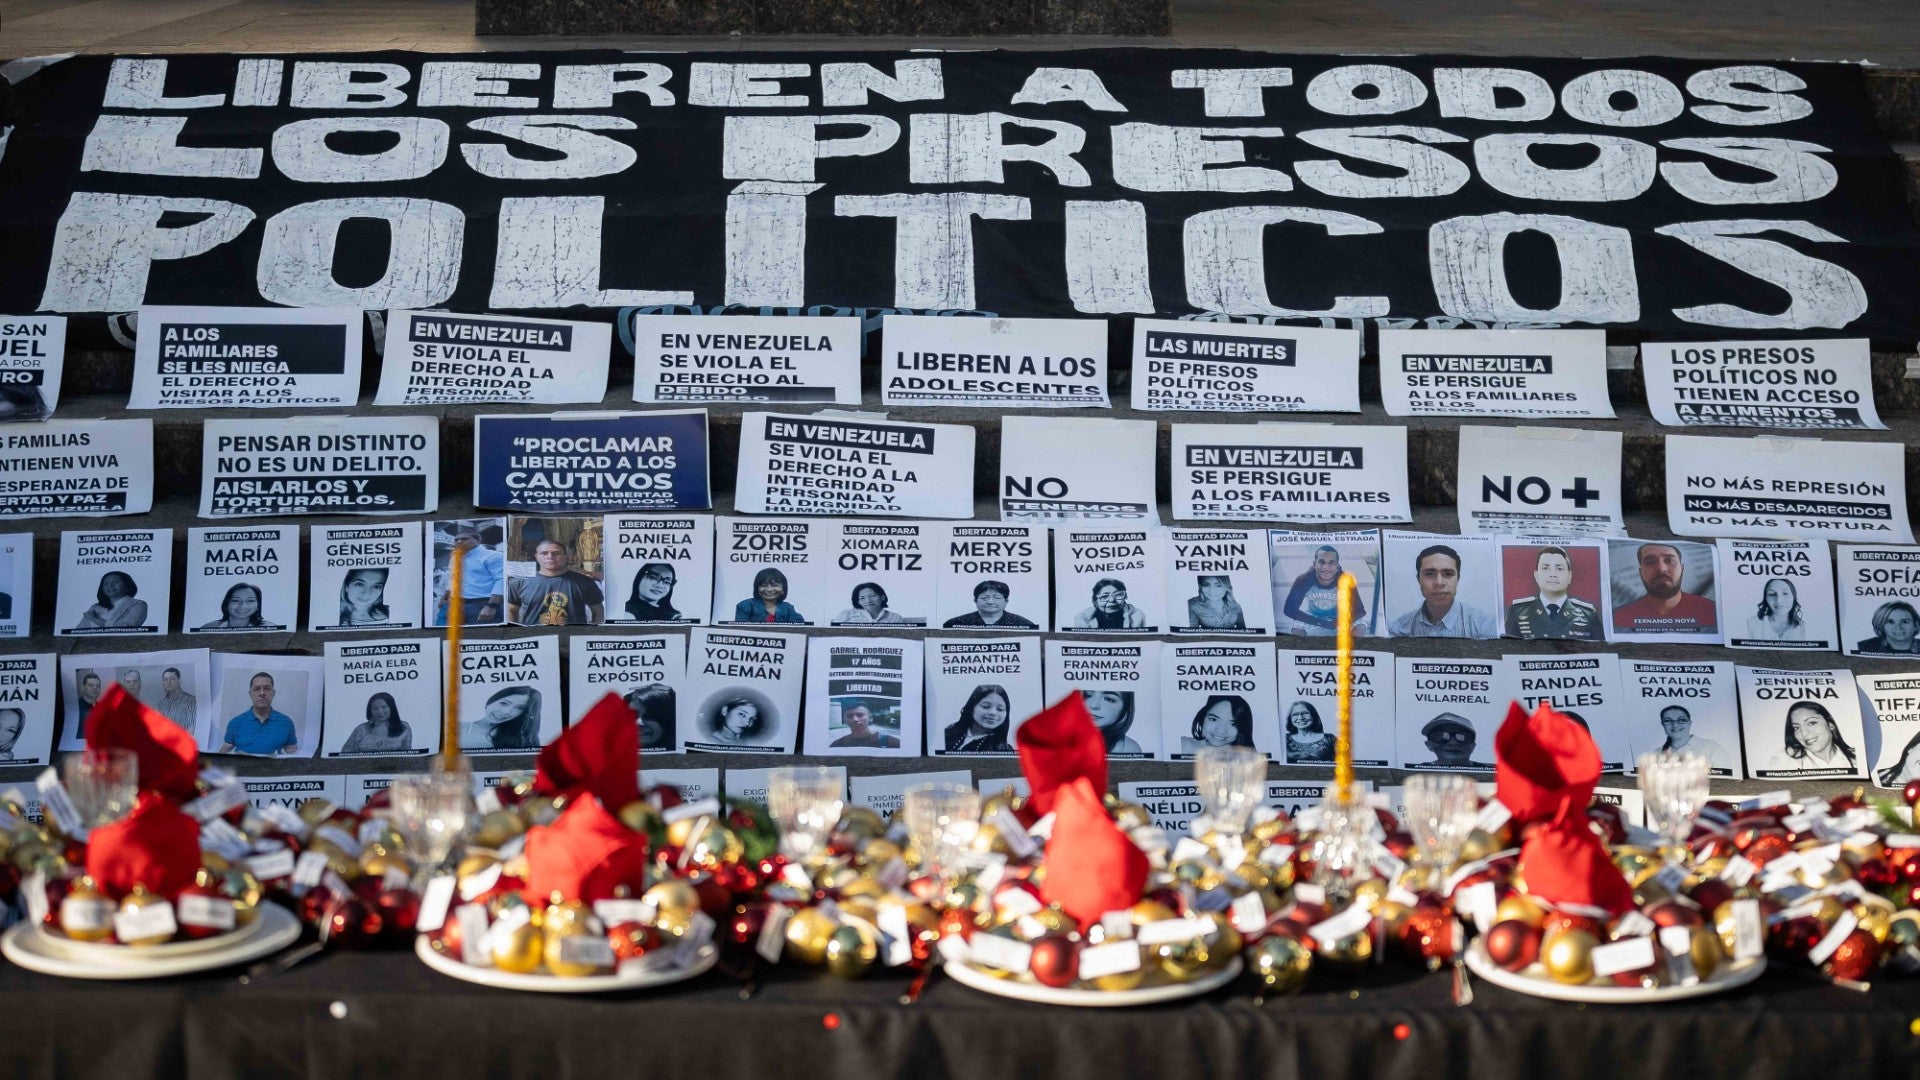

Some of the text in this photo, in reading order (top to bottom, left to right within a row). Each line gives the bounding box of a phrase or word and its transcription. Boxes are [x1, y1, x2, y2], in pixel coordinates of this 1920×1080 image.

[102, 58, 1814, 127] LIBEREN A TODOS
[80, 112, 1838, 204] LOS PRESOS
[36, 180, 1868, 329] POLÍTICOS
[2, 324, 47, 336] SAN
[165, 328, 220, 341] A LOS
[415, 322, 563, 346] EN VENEZUELA
[661, 334, 832, 351] EN VENEZUELA
[1150, 338, 1287, 360] LAS MUERTES
[164, 345, 278, 358] FAMILIARES
[412, 344, 530, 364] SE VIOLA EL
[1671, 348, 1815, 365] LOS PRESOS
[162, 362, 290, 374] SE LES NIEGA
[897, 352, 1096, 378] LIBEREN A LOS
[1149, 361, 1258, 379] DE PRESOS
[1406, 357, 1546, 372] EN VENEZUELA
[1407, 375, 1527, 388] SE PERSIGUE
[1673, 366, 1837, 384] POLÍTICOS NO
[889, 376, 1100, 395] ADOLESCENTES
[1148, 376, 1254, 392] POLÍTICOS
[1674, 388, 1860, 404] TIENEN ACCESO
[8, 433, 90, 448] FAMILIAS
[771, 422, 925, 448] EN VENEZUELA
[218, 434, 426, 452] PENSAR DISTINTO
[769, 443, 892, 465] SE VIOLA EL
[1191, 449, 1355, 467] EN VENEZUELA
[78, 455, 119, 468] VIVA
[218, 456, 421, 473] NO ES UN DELITO.
[511, 456, 677, 469] LIBERTAD A LOS
[506, 472, 673, 490] CAUTIVOS
[1191, 470, 1332, 486] SE PERSIGUE
[215, 480, 369, 495] AISLARLOS Y
[1005, 476, 1069, 498] NO
[1482, 475, 1551, 505] NO
[1687, 476, 1885, 496] NO MÁS REPRESIÓN
[214, 495, 395, 507] TORTURARLOS,
[1007, 502, 1137, 513] TENEMOS
[1688, 500, 1888, 517] NO MÁS DESAPARECIDOS
[1690, 516, 1891, 531] NO MÁS TORTURA
[844, 526, 916, 535] LIBERTAD PARA
[77, 535, 123, 543] LIBERTAD
[619, 534, 692, 544] DANIELA
[732, 535, 807, 551] ZORIS
[842, 539, 919, 550] XIOMARA
[1071, 534, 1115, 542] LIBERTAD
[78, 545, 152, 556] DIGNORA
[205, 545, 278, 563] MARÍA
[326, 541, 401, 556] GÉNESIS
[621, 545, 691, 560] ARAÑA
[950, 542, 1032, 556] MERYS
[1072, 545, 1145, 559] YOSIDA
[1175, 544, 1245, 557] YANIN
[77, 555, 152, 565] HERNÁNDEZ
[327, 556, 402, 567] RODRÍGUEZ
[730, 552, 809, 563] GUTIÉRREZ
[839, 554, 922, 571] ORTIZ
[1734, 550, 1811, 562] MARÍA
[204, 565, 279, 575] DELGADO
[950, 561, 1032, 573] TORRES
[1074, 561, 1144, 573] VANEGAS
[1175, 558, 1249, 571] PERNÍA
[1737, 565, 1811, 576] CUICAS
[1859, 567, 1920, 583] SOFÍA
[341, 645, 417, 656] LIBERTAD PARA
[942, 644, 988, 652] LIBERTAD
[461, 654, 537, 670] CARLA
[588, 654, 665, 668] ÁNGELA
[704, 648, 785, 664] YOLIMAR
[862, 657, 881, 665] AÑOS
[942, 655, 1021, 664] SAMANTHA
[343, 658, 417, 670] MARÍA ELBA
[943, 664, 1021, 674] HERNÁNDEZ
[1064, 661, 1139, 669] FRANMARY
[1177, 665, 1256, 676] SAMAIRA
[1413, 665, 1489, 674] LIBERTAD PARA
[344, 670, 419, 684] DELGADO
[462, 671, 539, 684] DA SILVA
[588, 670, 665, 683] EXPÓSITO
[703, 662, 782, 680] ALEMÁN
[1064, 671, 1140, 681] QUINTERO
[1179, 680, 1256, 691] ROMERO
[1416, 679, 1489, 691] LOURDES
[1521, 676, 1602, 690] RANDAL
[1639, 676, 1712, 686] CATALINA
[1755, 678, 1836, 686] JENNIFER
[846, 684, 882, 692] LIBERTAD
[1642, 687, 1710, 698] RAMOS
[1756, 688, 1839, 699] OZUNA
[1415, 693, 1491, 704] VILLARREAL
[1137, 788, 1186, 796] LIBERTAD
